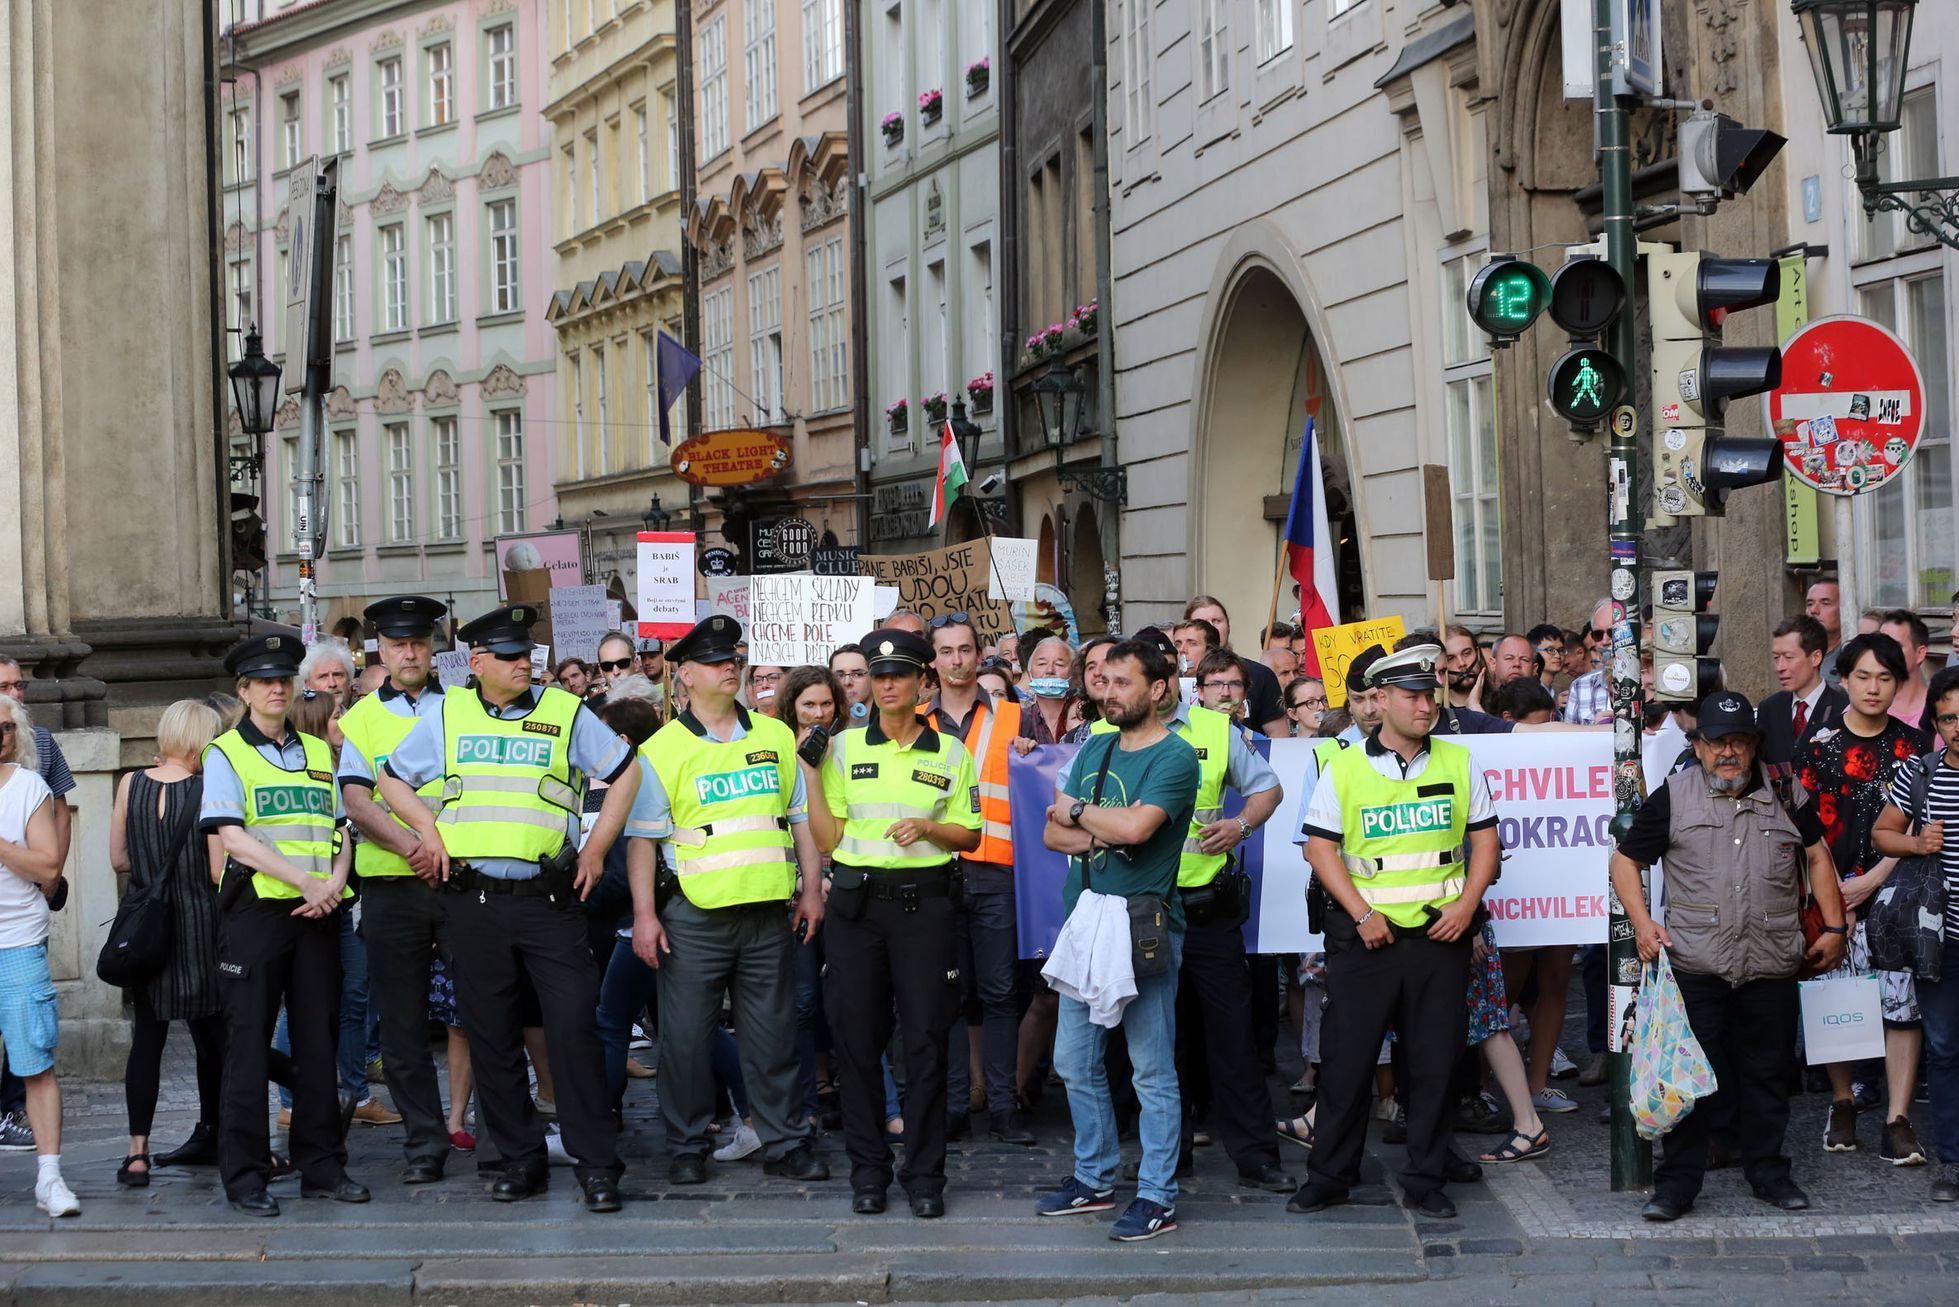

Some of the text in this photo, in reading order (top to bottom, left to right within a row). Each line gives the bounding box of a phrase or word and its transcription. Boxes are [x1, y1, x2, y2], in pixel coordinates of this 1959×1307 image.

[1806, 185, 1816, 213] 2
[1793, 267, 1801, 307] Art
[1498, 280, 1528, 319] 12
[687, 444, 776, 462] BLACK LIGHT
[703, 459, 763, 474] THEATRE
[782, 528, 808, 541] GOOD
[652, 551, 680, 560] BABIŠ
[783, 541, 808, 555] FOOD
[816, 550, 857, 562] MUSIC
[858, 561, 888, 579] PANE
[941, 547, 974, 572] JSTE
[543, 560, 578, 571] Gelato
[653, 576, 679, 584] SRAB
[653, 605, 680, 614] debaty
[752, 623, 796, 642] CHCEME
[803, 623, 835, 643] POLE
[1318, 634, 1336, 649] KDY
[525, 722, 559, 734] 250879
[458, 740, 549, 763] POLICIE
[916, 759, 951, 772] POLICIE
[697, 769, 779, 801] POLICIE
[1484, 766, 1615, 801] CHVILE
[257, 789, 333, 814] POLICIE
[1363, 803, 1451, 834] POLICIE
[219, 962, 243, 975] POLICIE
[1822, 1012, 1864, 1026] IQOS
